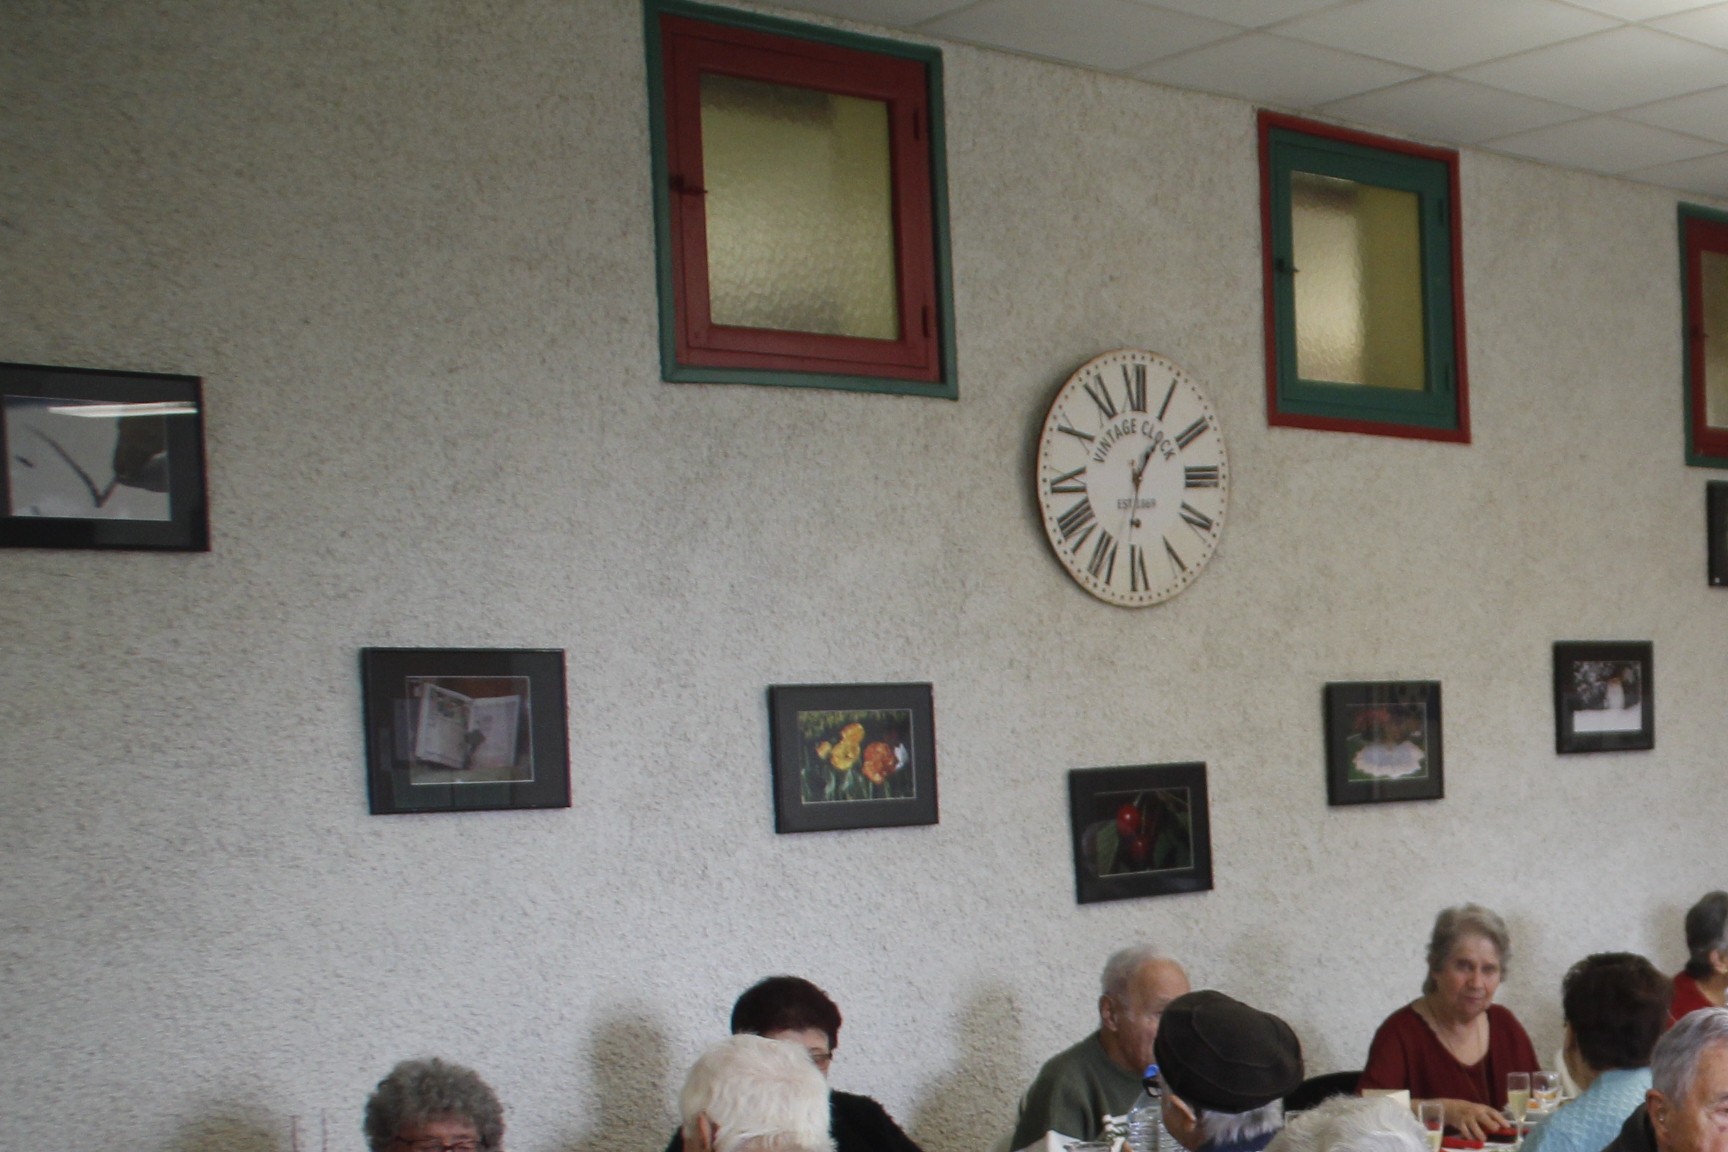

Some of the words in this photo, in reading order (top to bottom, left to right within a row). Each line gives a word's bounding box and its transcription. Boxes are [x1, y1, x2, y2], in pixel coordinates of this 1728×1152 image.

[1084, 374, 1117, 428] XI
[1121, 364, 1147, 414] XII
[1058, 412, 1095, 455] X
[1093, 418, 1137, 463] VINTAGE
[1141, 420, 1176, 461] CLOCK
[1184, 465, 1219, 488] III
[1129, 544, 1150, 592] VI
